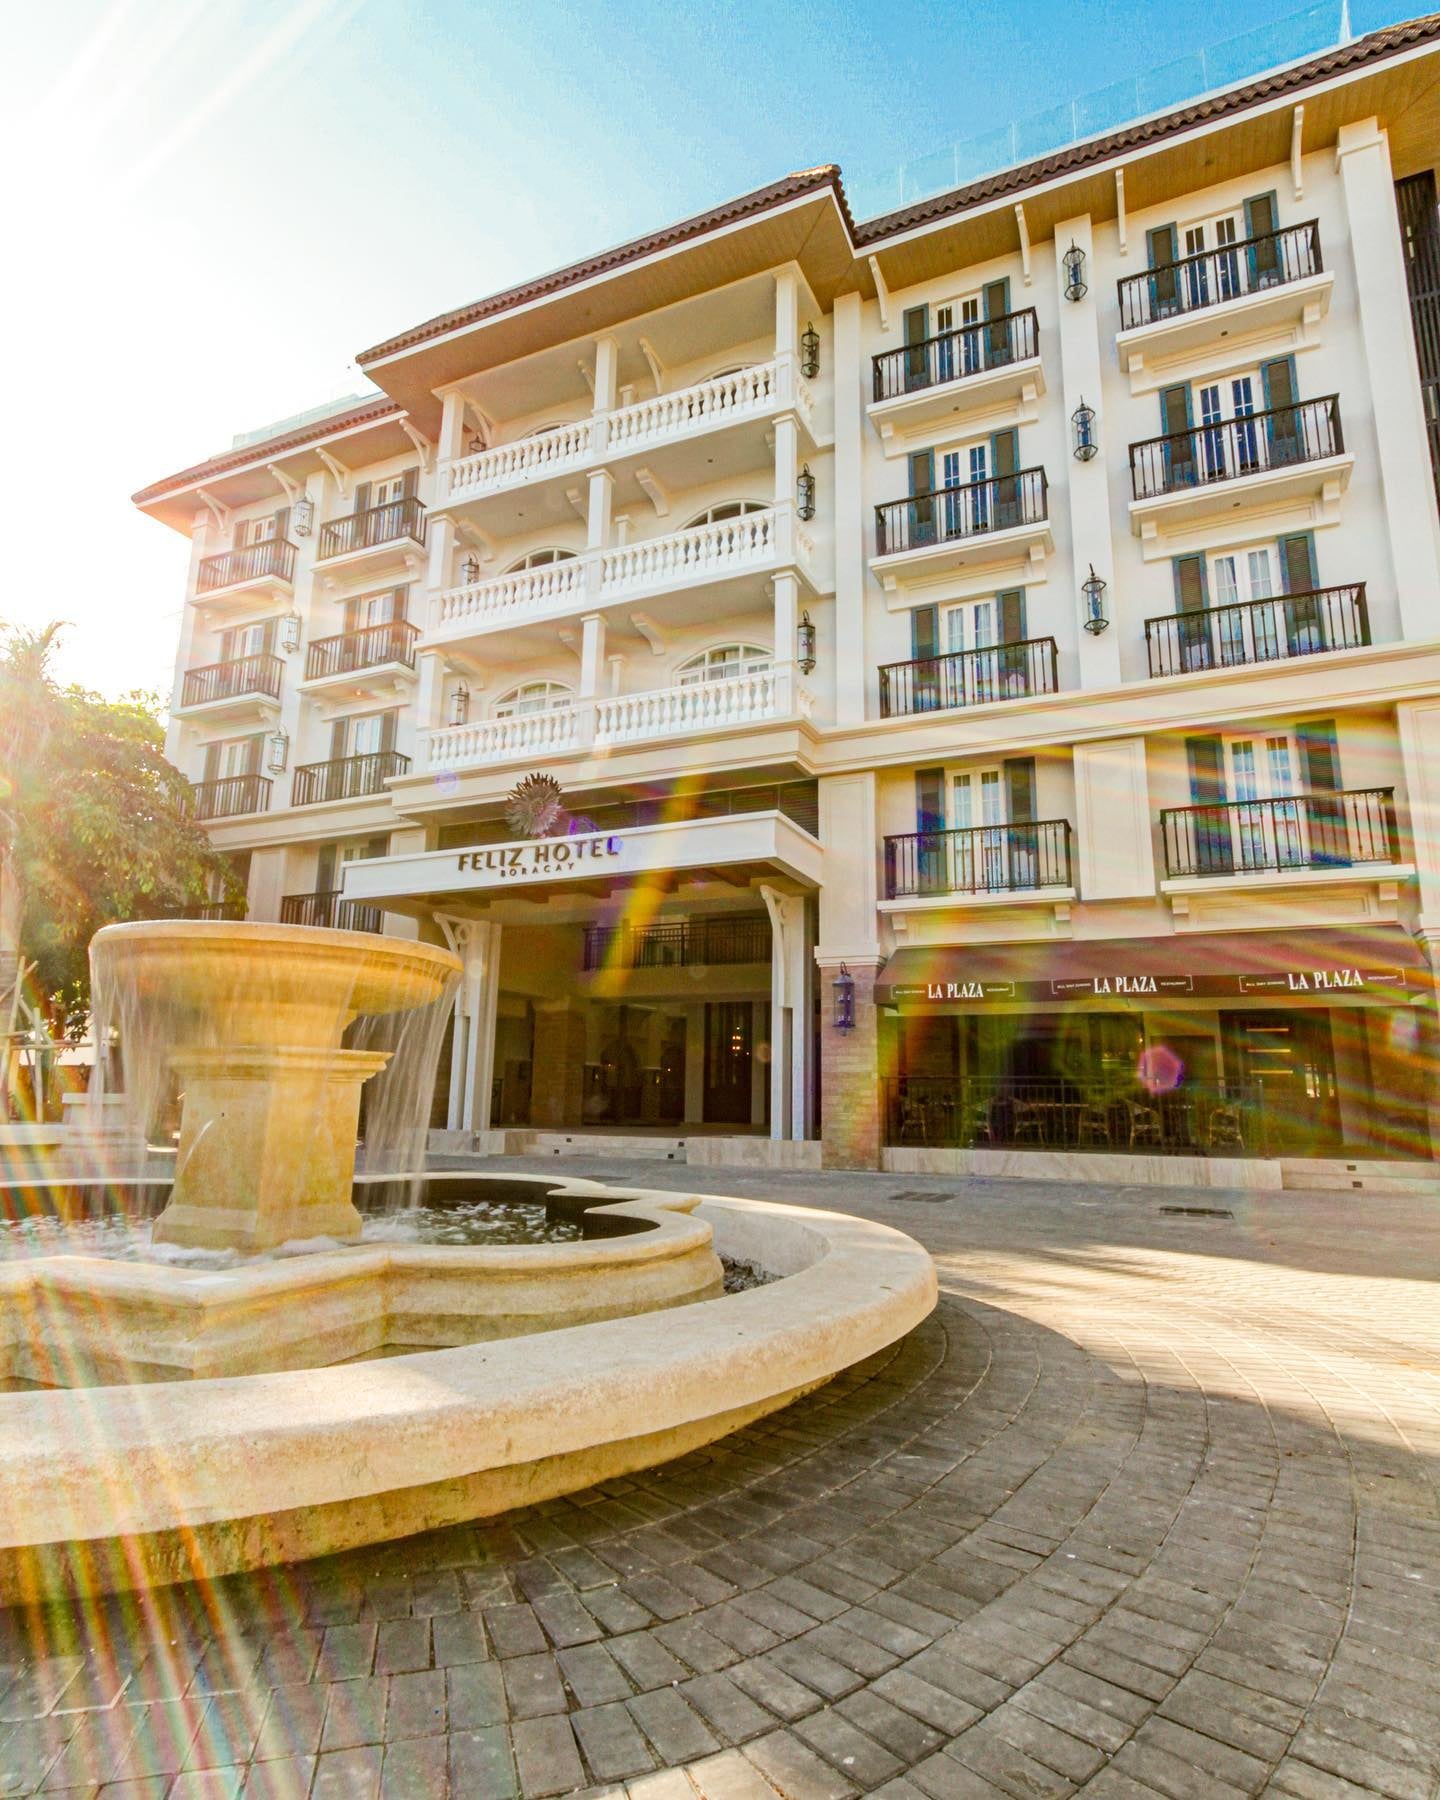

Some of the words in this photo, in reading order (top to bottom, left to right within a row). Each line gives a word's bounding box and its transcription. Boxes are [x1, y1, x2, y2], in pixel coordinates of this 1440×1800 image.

[458, 848, 523, 872] FELIZ
[534, 837, 620, 864] HOTEL
[500, 862, 575, 878] BORACAY
[1094, 977, 1111, 993] LA
[1115, 976, 1157, 993] PLAZA
[1288, 973, 1309, 990] LA
[1313, 969, 1364, 989] PLAZA
[928, 983, 943, 999] LA
[947, 982, 984, 999] PLAZA
